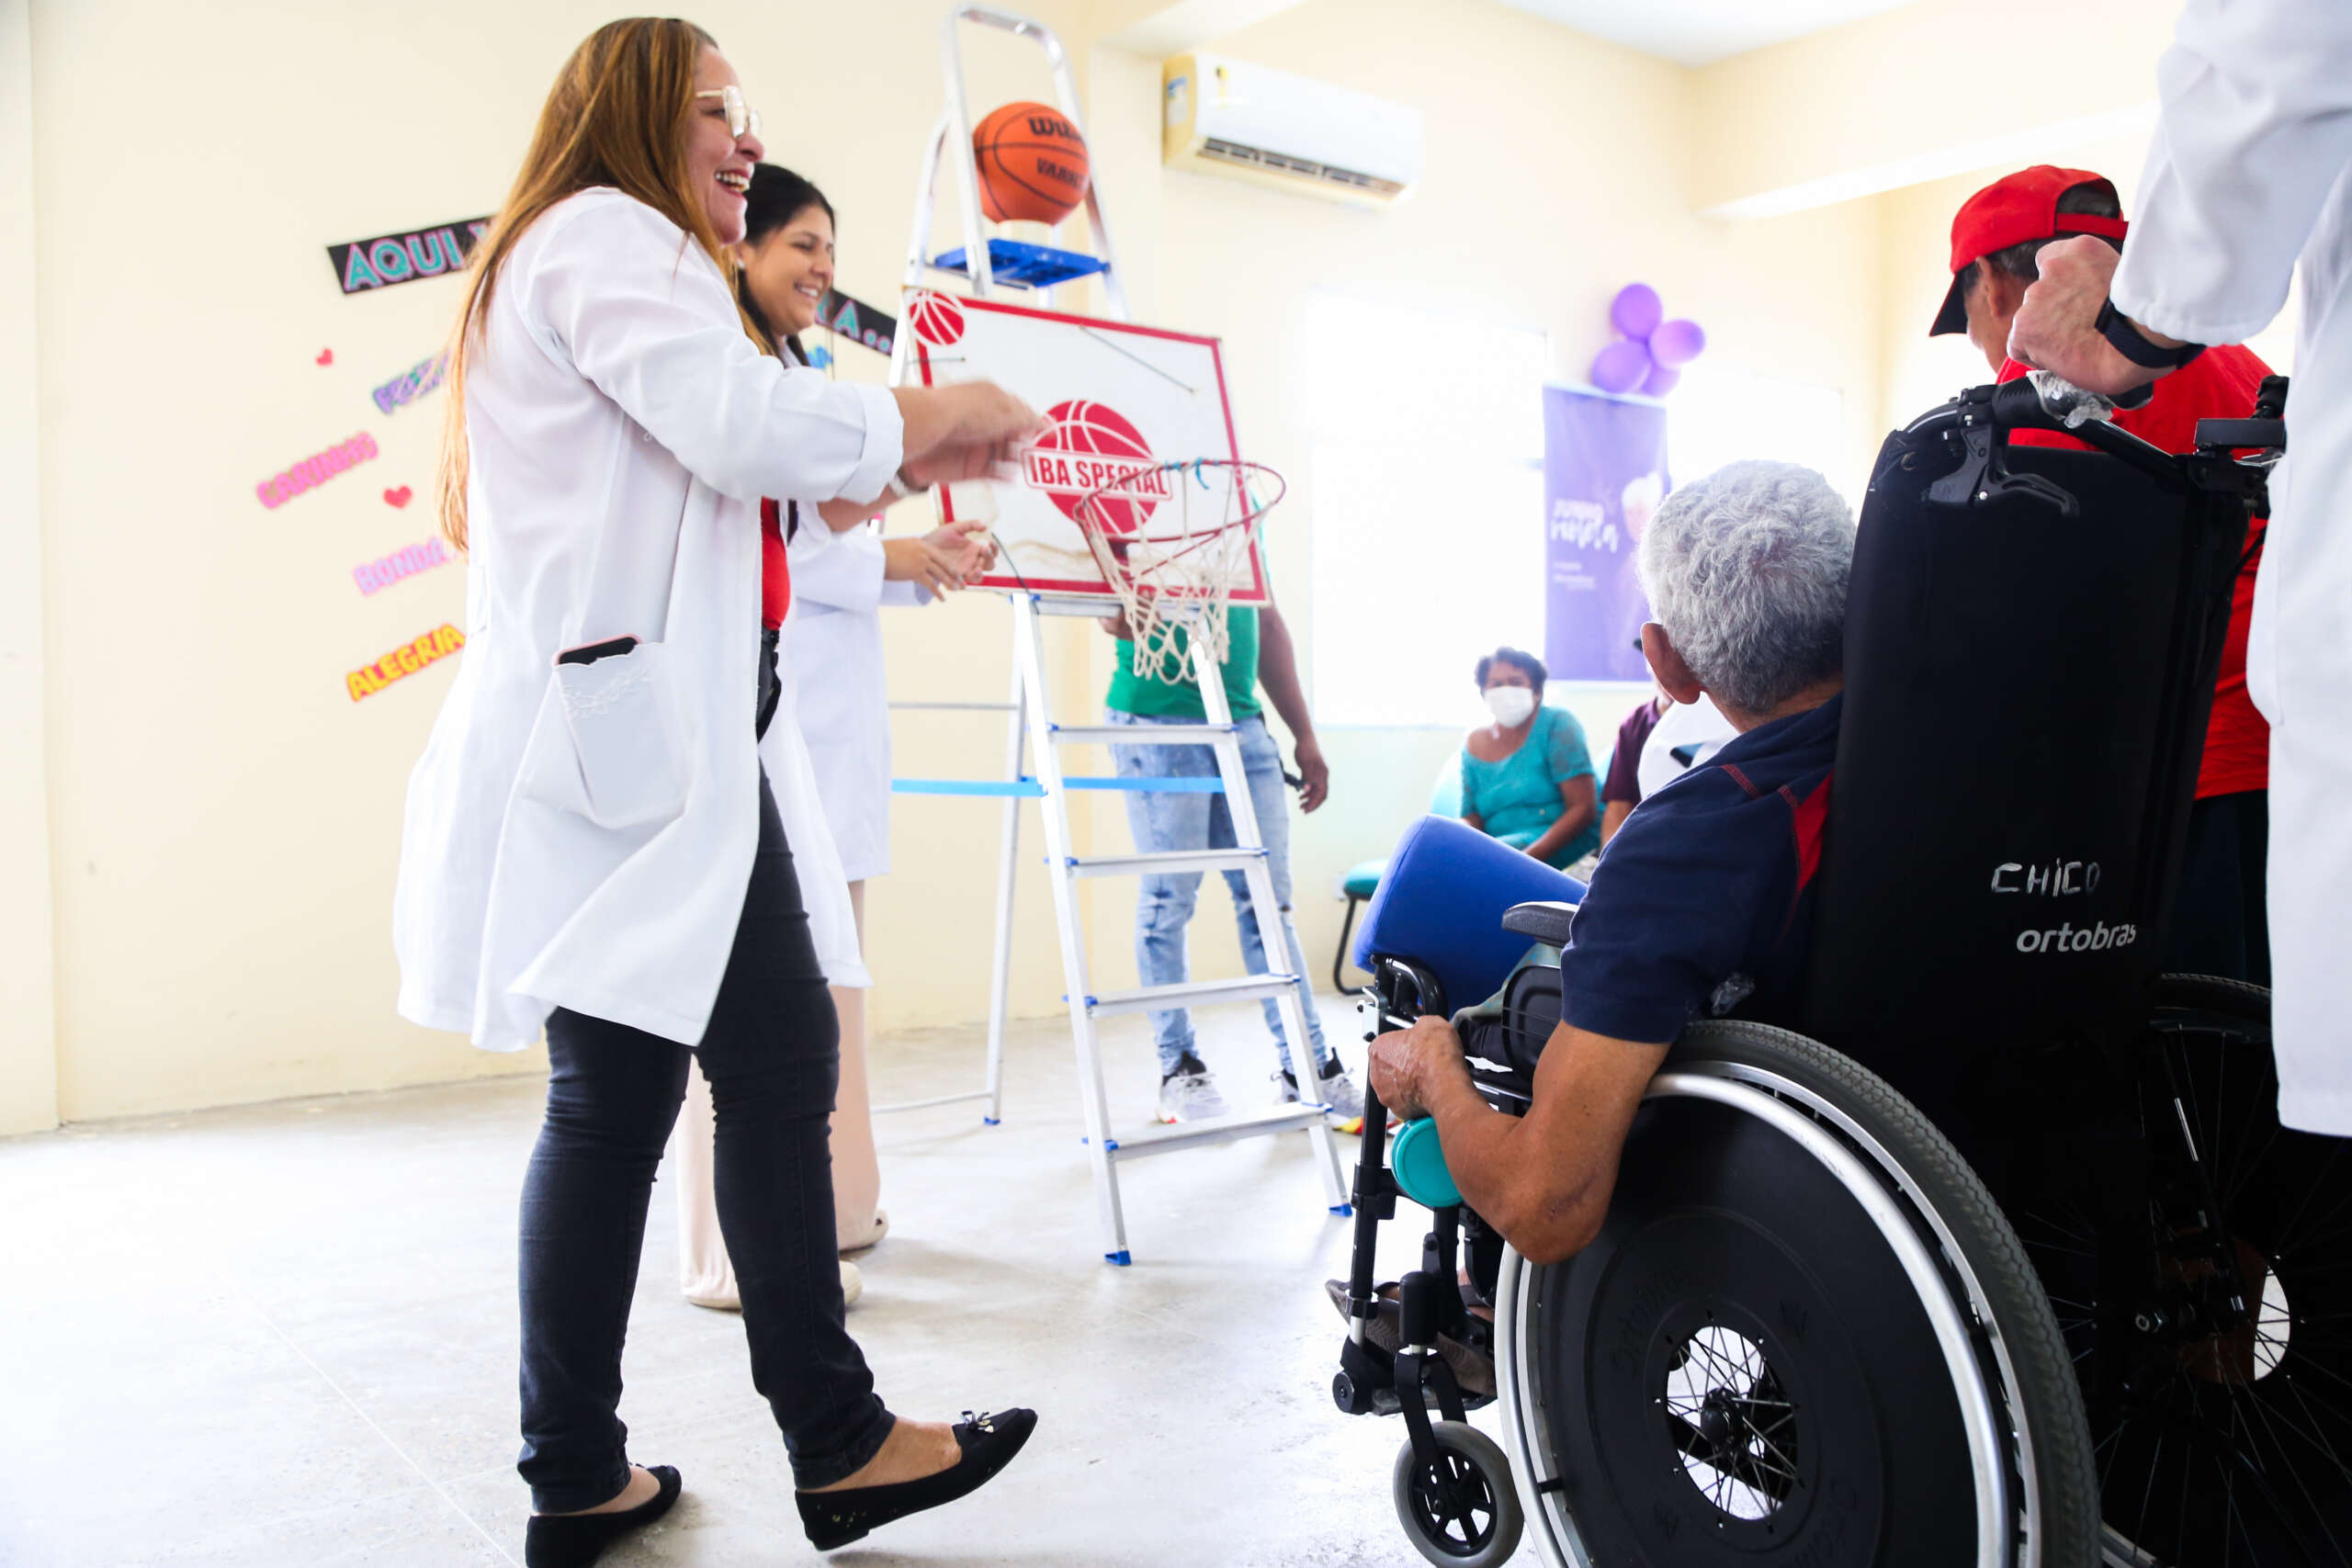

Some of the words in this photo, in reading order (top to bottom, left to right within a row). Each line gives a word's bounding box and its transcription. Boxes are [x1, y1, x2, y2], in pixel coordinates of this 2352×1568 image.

[344, 228, 466, 292] AQUI
[256, 431, 379, 510] CARINHO
[1028, 455, 1071, 486] IBA
[353, 536, 449, 596] BONDA
[345, 623, 466, 702] ALEGRIA
[2017, 921, 2137, 953] ortobras
